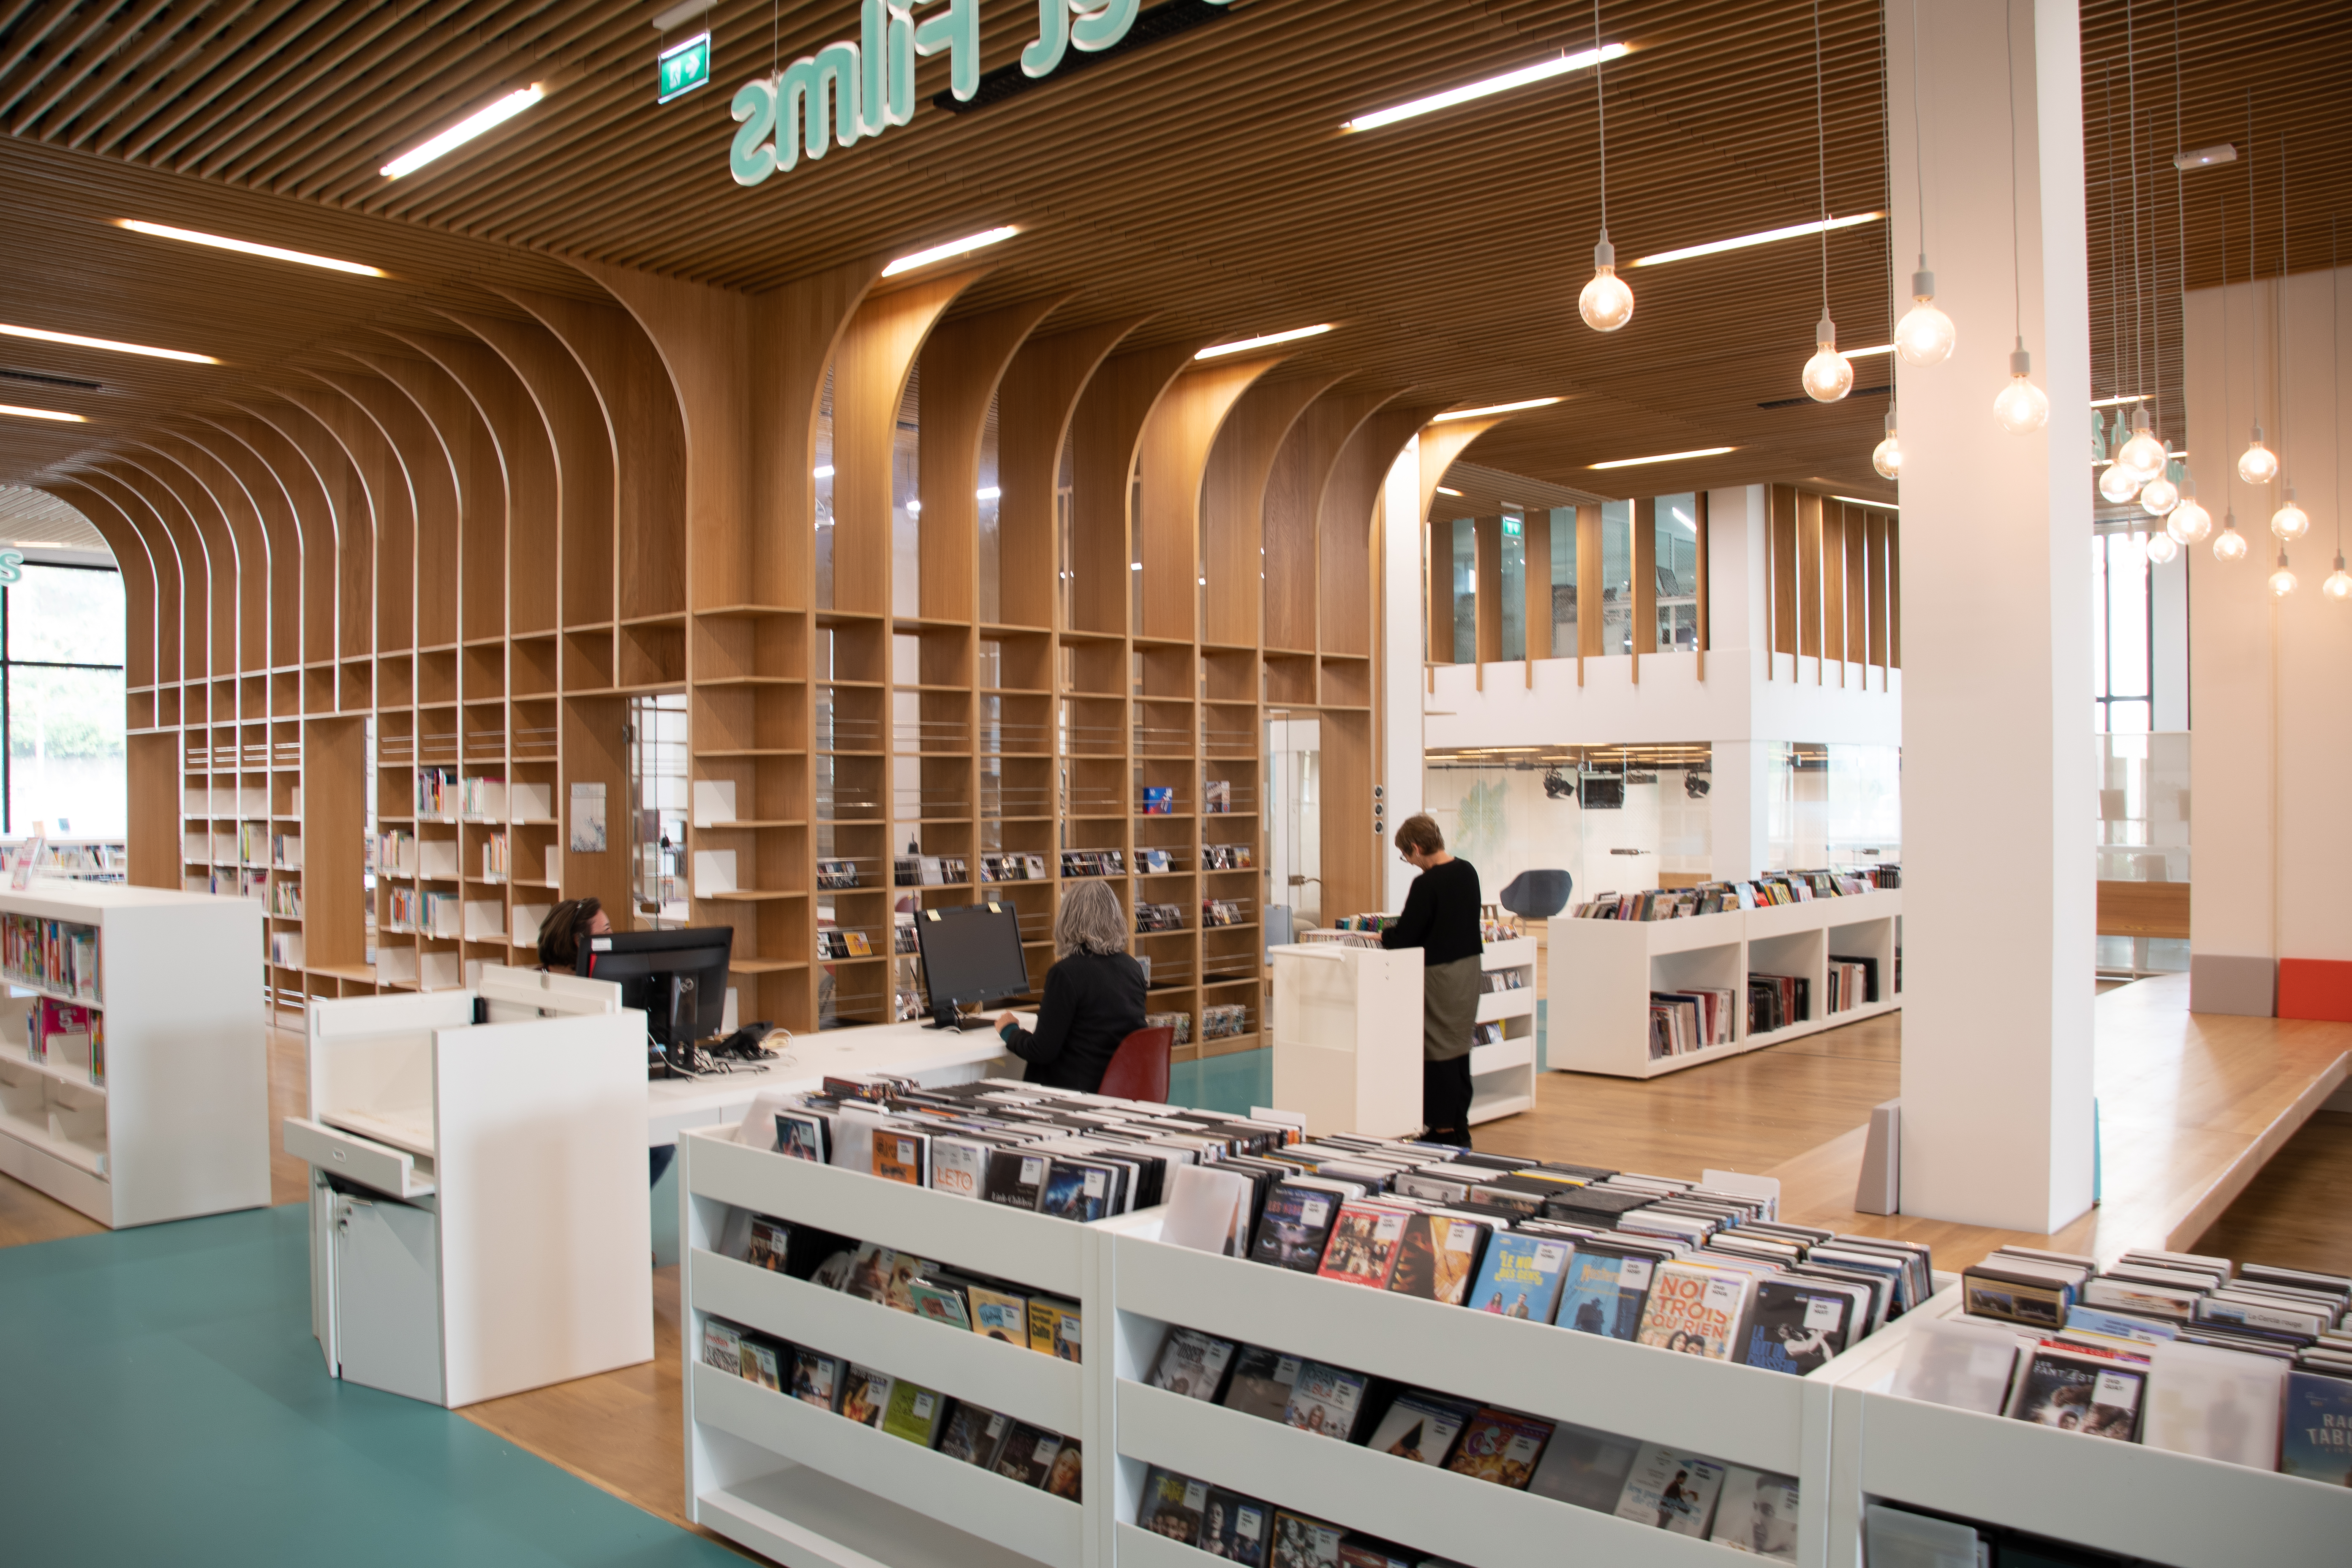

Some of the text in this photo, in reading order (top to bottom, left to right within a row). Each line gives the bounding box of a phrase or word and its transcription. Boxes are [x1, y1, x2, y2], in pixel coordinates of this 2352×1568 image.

[935, 1165, 973, 1191] LETO
[1516, 1256, 1533, 1269] NO
[1658, 1295, 1728, 1324] TROIS
[1652, 1314, 1725, 1339] OU RIEN
[2281, 1320, 2302, 1328] rouge
